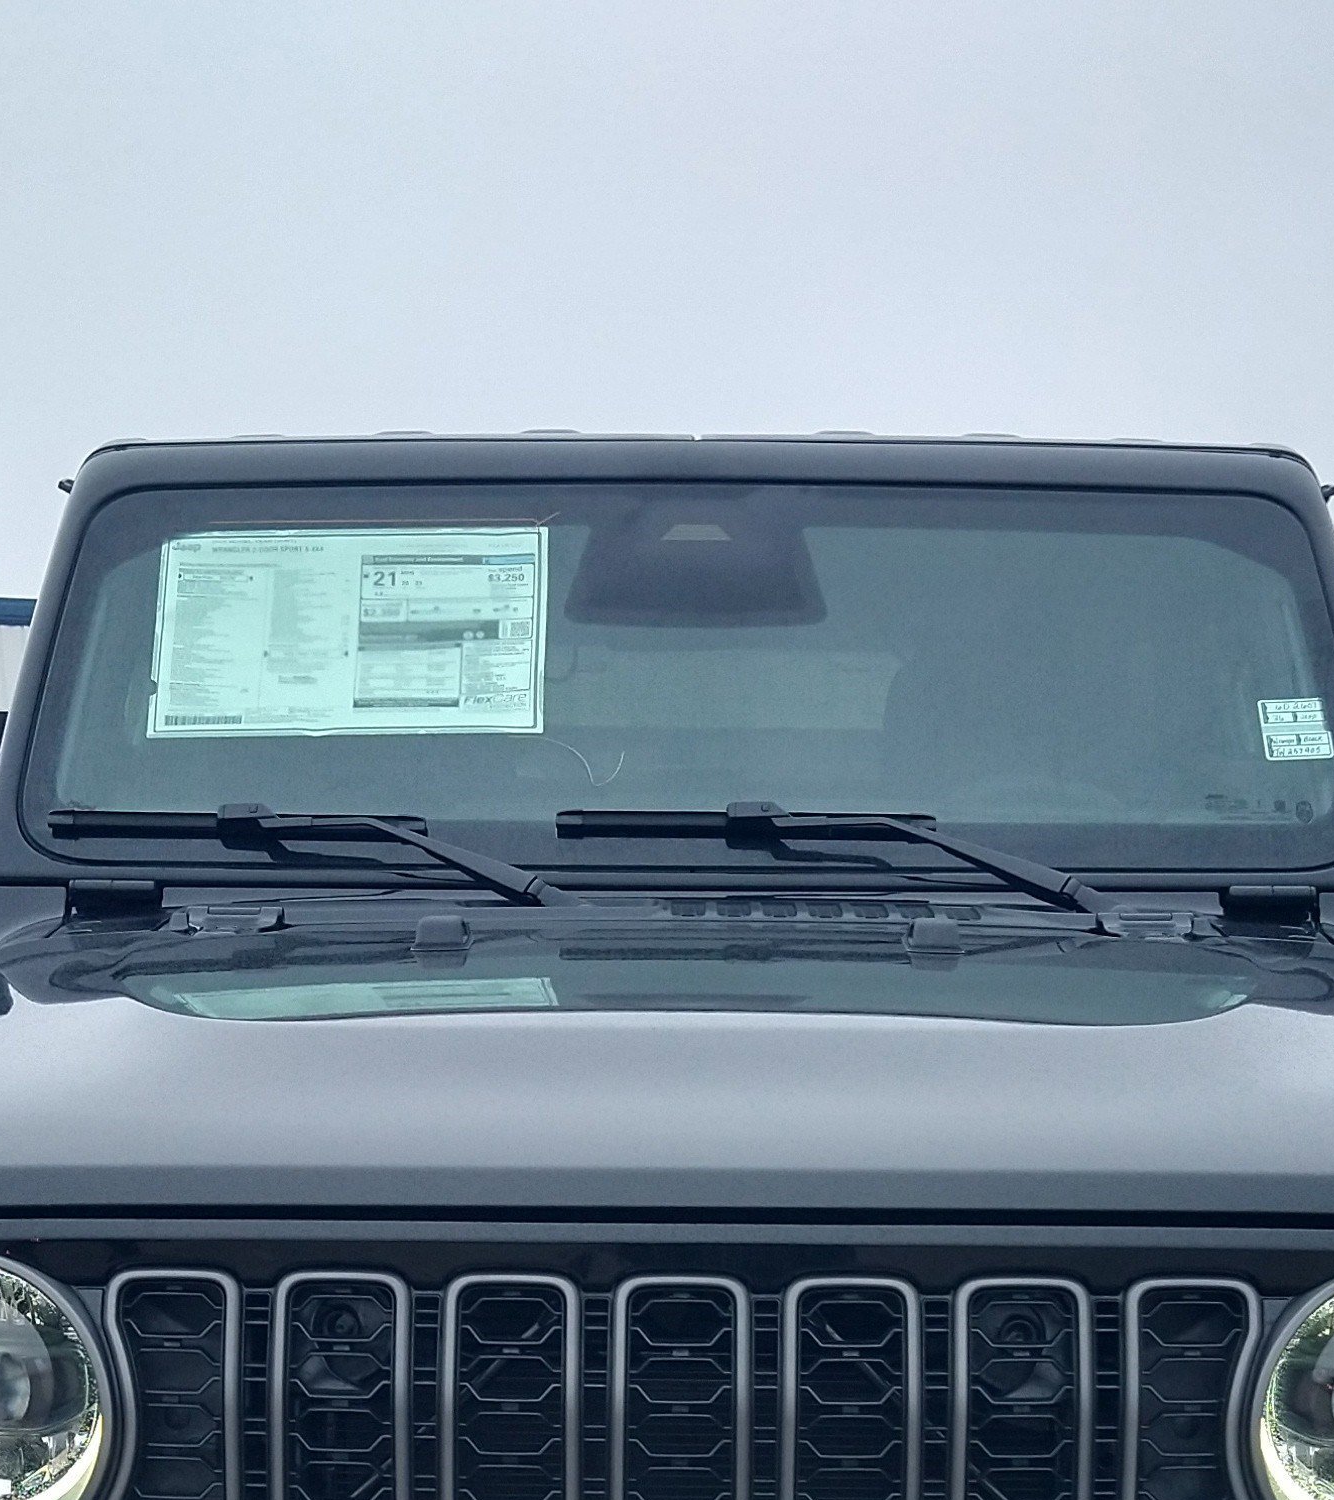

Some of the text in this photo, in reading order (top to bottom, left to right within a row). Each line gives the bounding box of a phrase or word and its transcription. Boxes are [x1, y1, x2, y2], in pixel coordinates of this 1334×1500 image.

[373, 571, 396, 586] 21
[488, 573, 525, 582] $3,250
[464, 693, 527, 704] FlexCare
